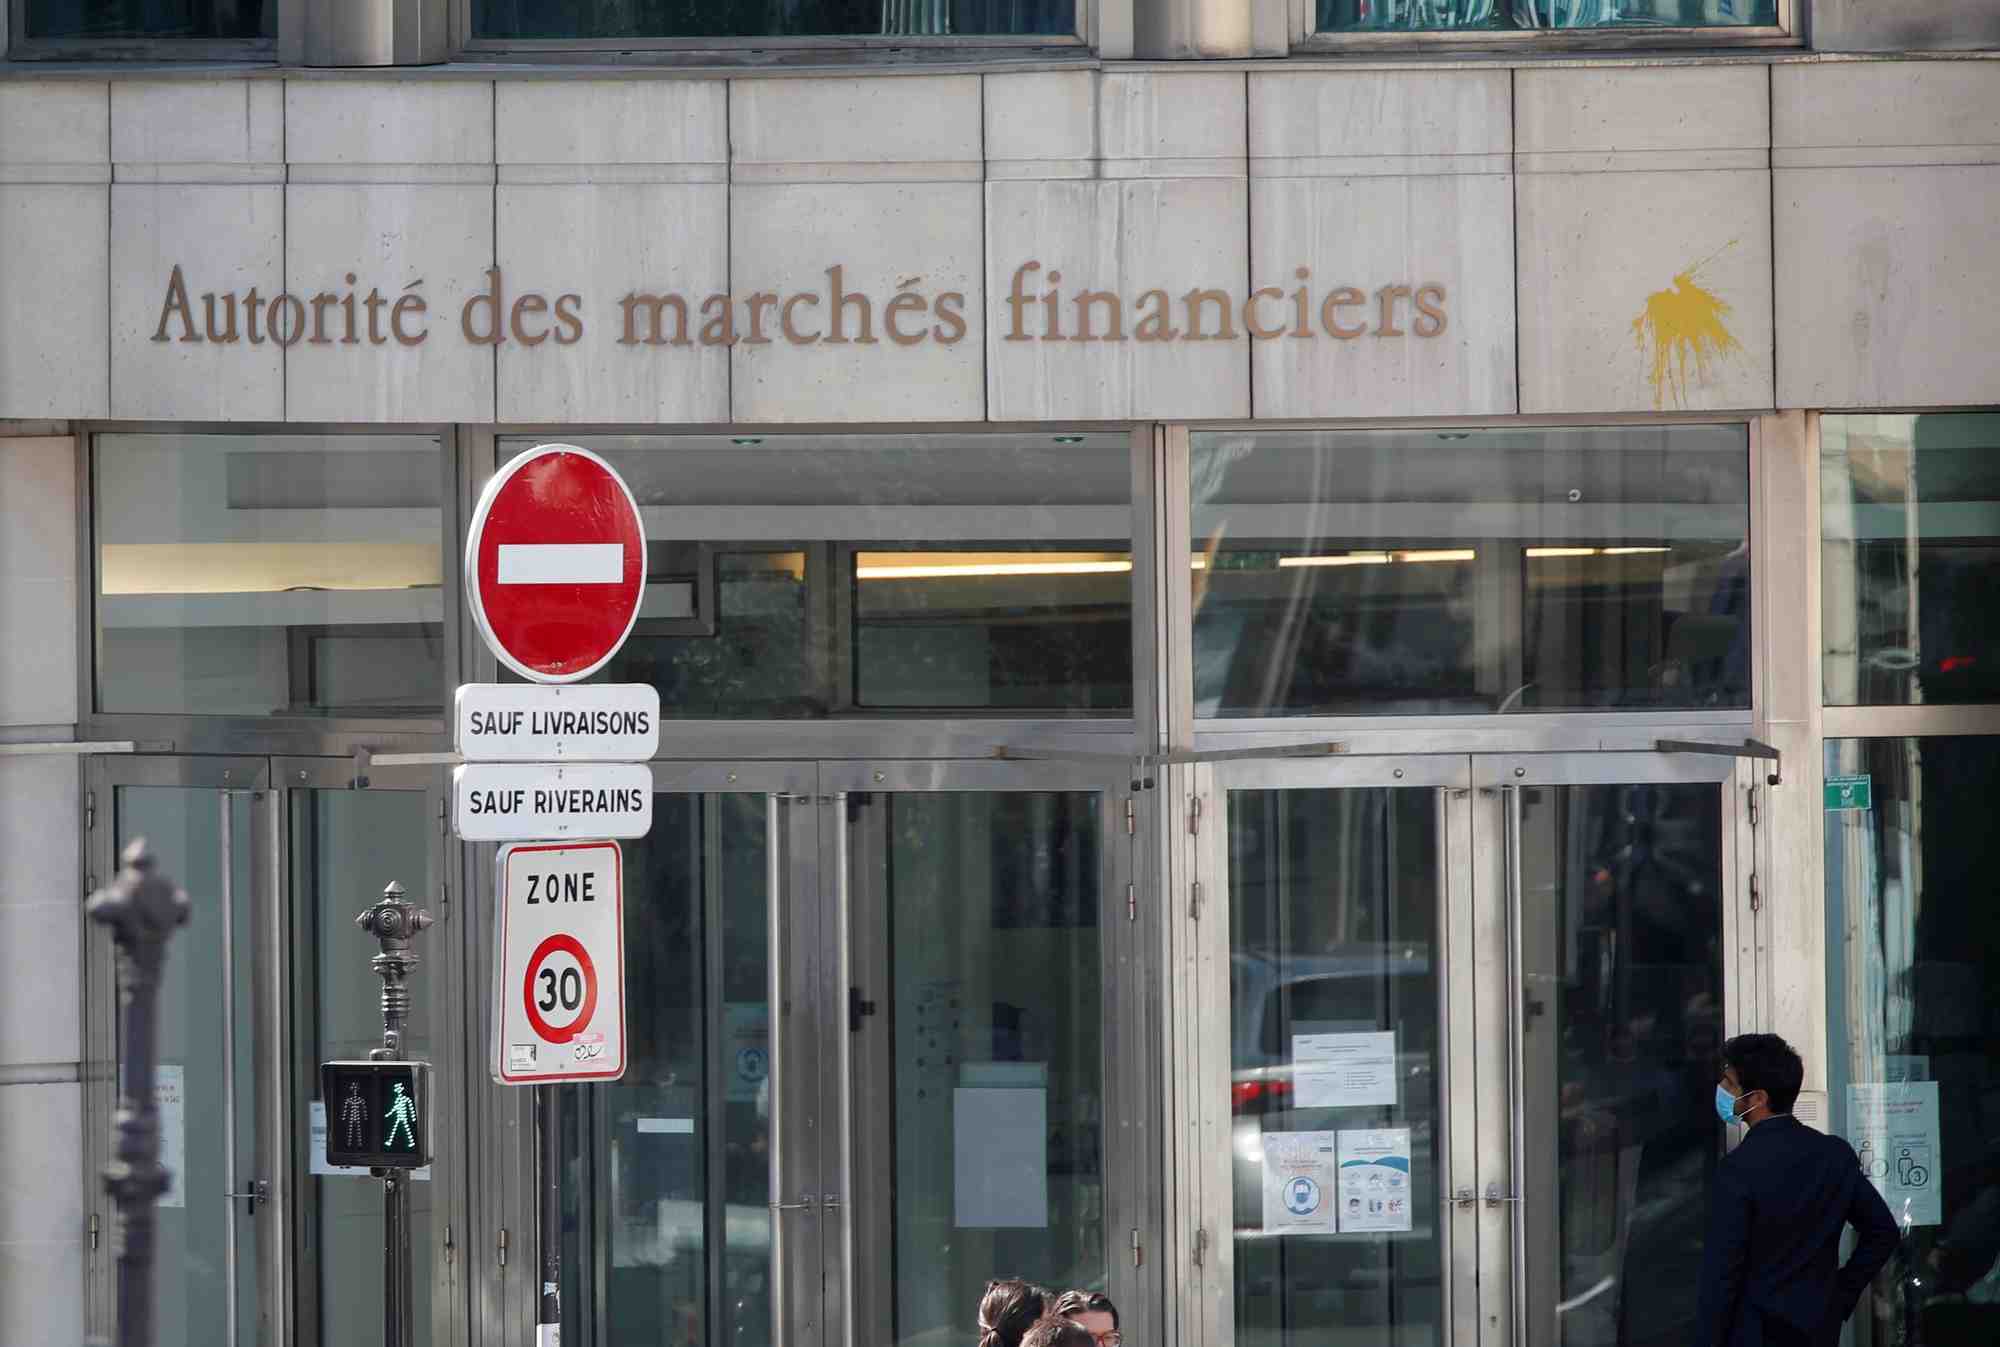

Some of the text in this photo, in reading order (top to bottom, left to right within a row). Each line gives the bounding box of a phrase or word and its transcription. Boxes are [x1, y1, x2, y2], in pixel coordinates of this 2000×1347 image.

[150, 260, 1450, 348] Autorité des marchés financiers
[470, 711, 650, 735] SAUF LIVRAISONS
[470, 789, 642, 814] SAUF RIVERAINS
[527, 872, 595, 904] ZONE
[538, 967, 582, 1012] 30
